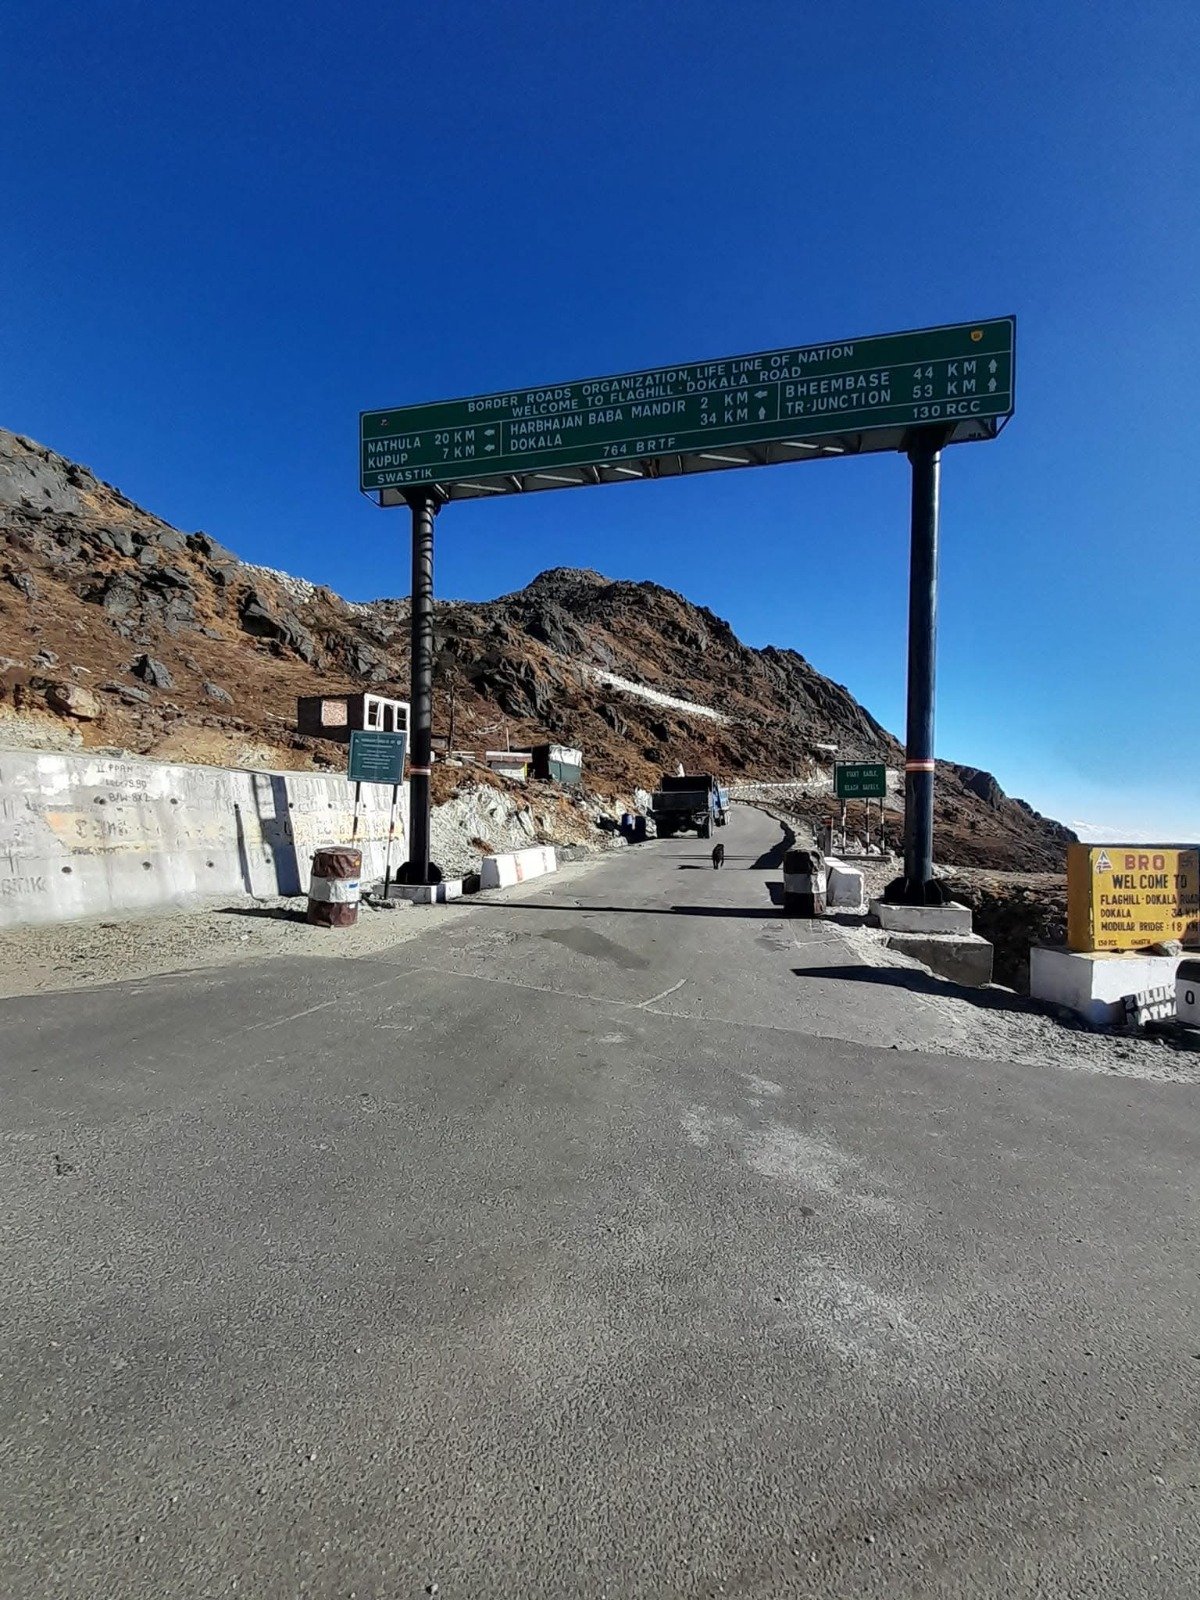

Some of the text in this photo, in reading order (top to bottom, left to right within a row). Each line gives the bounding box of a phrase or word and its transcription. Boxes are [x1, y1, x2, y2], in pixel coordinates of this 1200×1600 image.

[468, 345, 854, 413] BORDER ROADS ORGANIZATION, LIFE LINE OF NATION
[786, 372, 890, 398] BHEEMBASE
[912, 366, 934, 380] 44
[512, 399, 578, 416] WELCOME
[586, 395, 604, 407] TO
[760, 366, 801, 382] ROAD
[786, 389, 892, 415] TR-JUNCTION
[912, 384, 934, 398] 53
[510, 414, 583, 435] HARBHAJAN
[588, 408, 623, 425] BABA
[632, 400, 686, 419] MANDIR
[700, 397, 708, 410] 2
[912, 400, 981, 418] 130 RCC
[510, 434, 562, 452] DOKALA
[700, 412, 717, 426] 34
[368, 436, 421, 454] NATHULA
[434, 433, 449, 446] 20
[603, 438, 676, 456] 764 BRTF
[368, 453, 408, 469] KUPUP
[442, 448, 448, 460] 7
[378, 465, 432, 484] SWASTIK
[1124, 854, 1165, 870] BRO
[1174, 874, 1188, 889] TO
[1100, 908, 1132, 918] DOKALA
[1170, 908, 1183, 918] 34
[1101, 922, 1135, 931] MODULAR
[1139, 922, 1164, 931] BRIDGE
[1171, 920, 1182, 931] 18
[1124, 984, 1176, 1009] ZULUK
